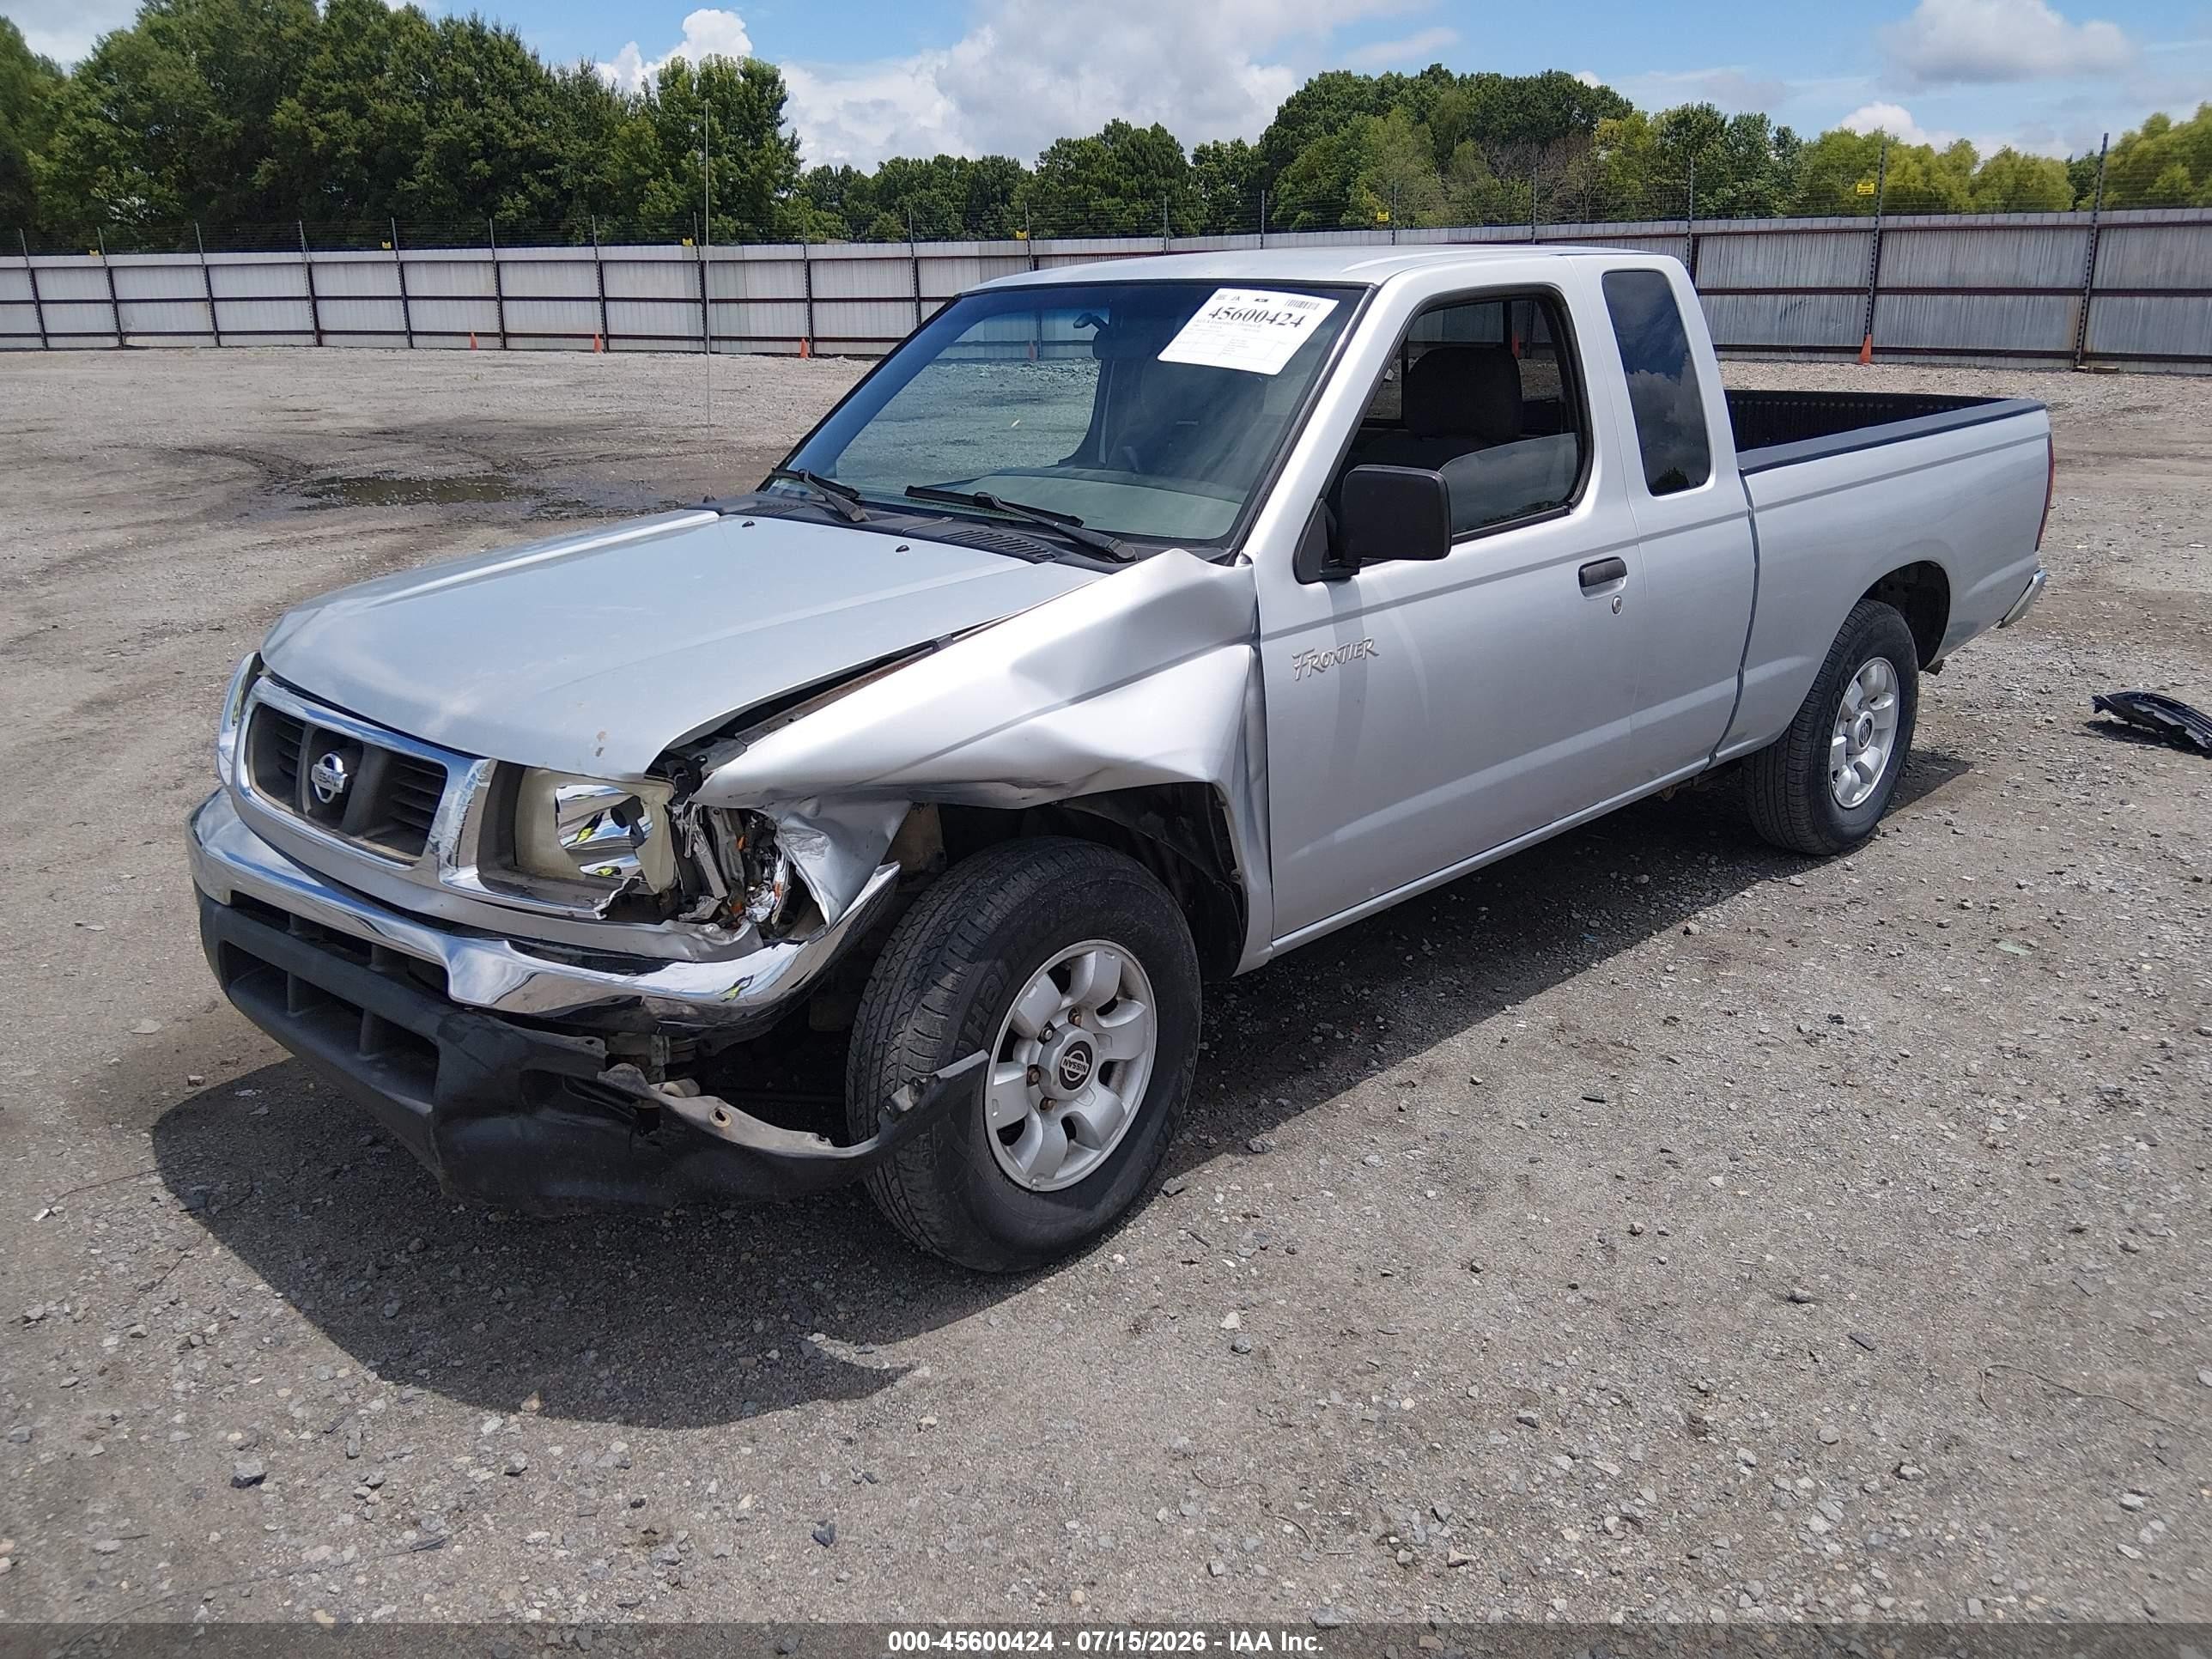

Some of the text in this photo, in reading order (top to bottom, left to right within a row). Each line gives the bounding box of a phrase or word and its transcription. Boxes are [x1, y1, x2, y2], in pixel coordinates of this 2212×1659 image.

[1208, 307, 1306, 328] 45600424
[1291, 637, 1380, 681] FRONTIER
[1062, 1057, 1088, 1073] NISSAN
